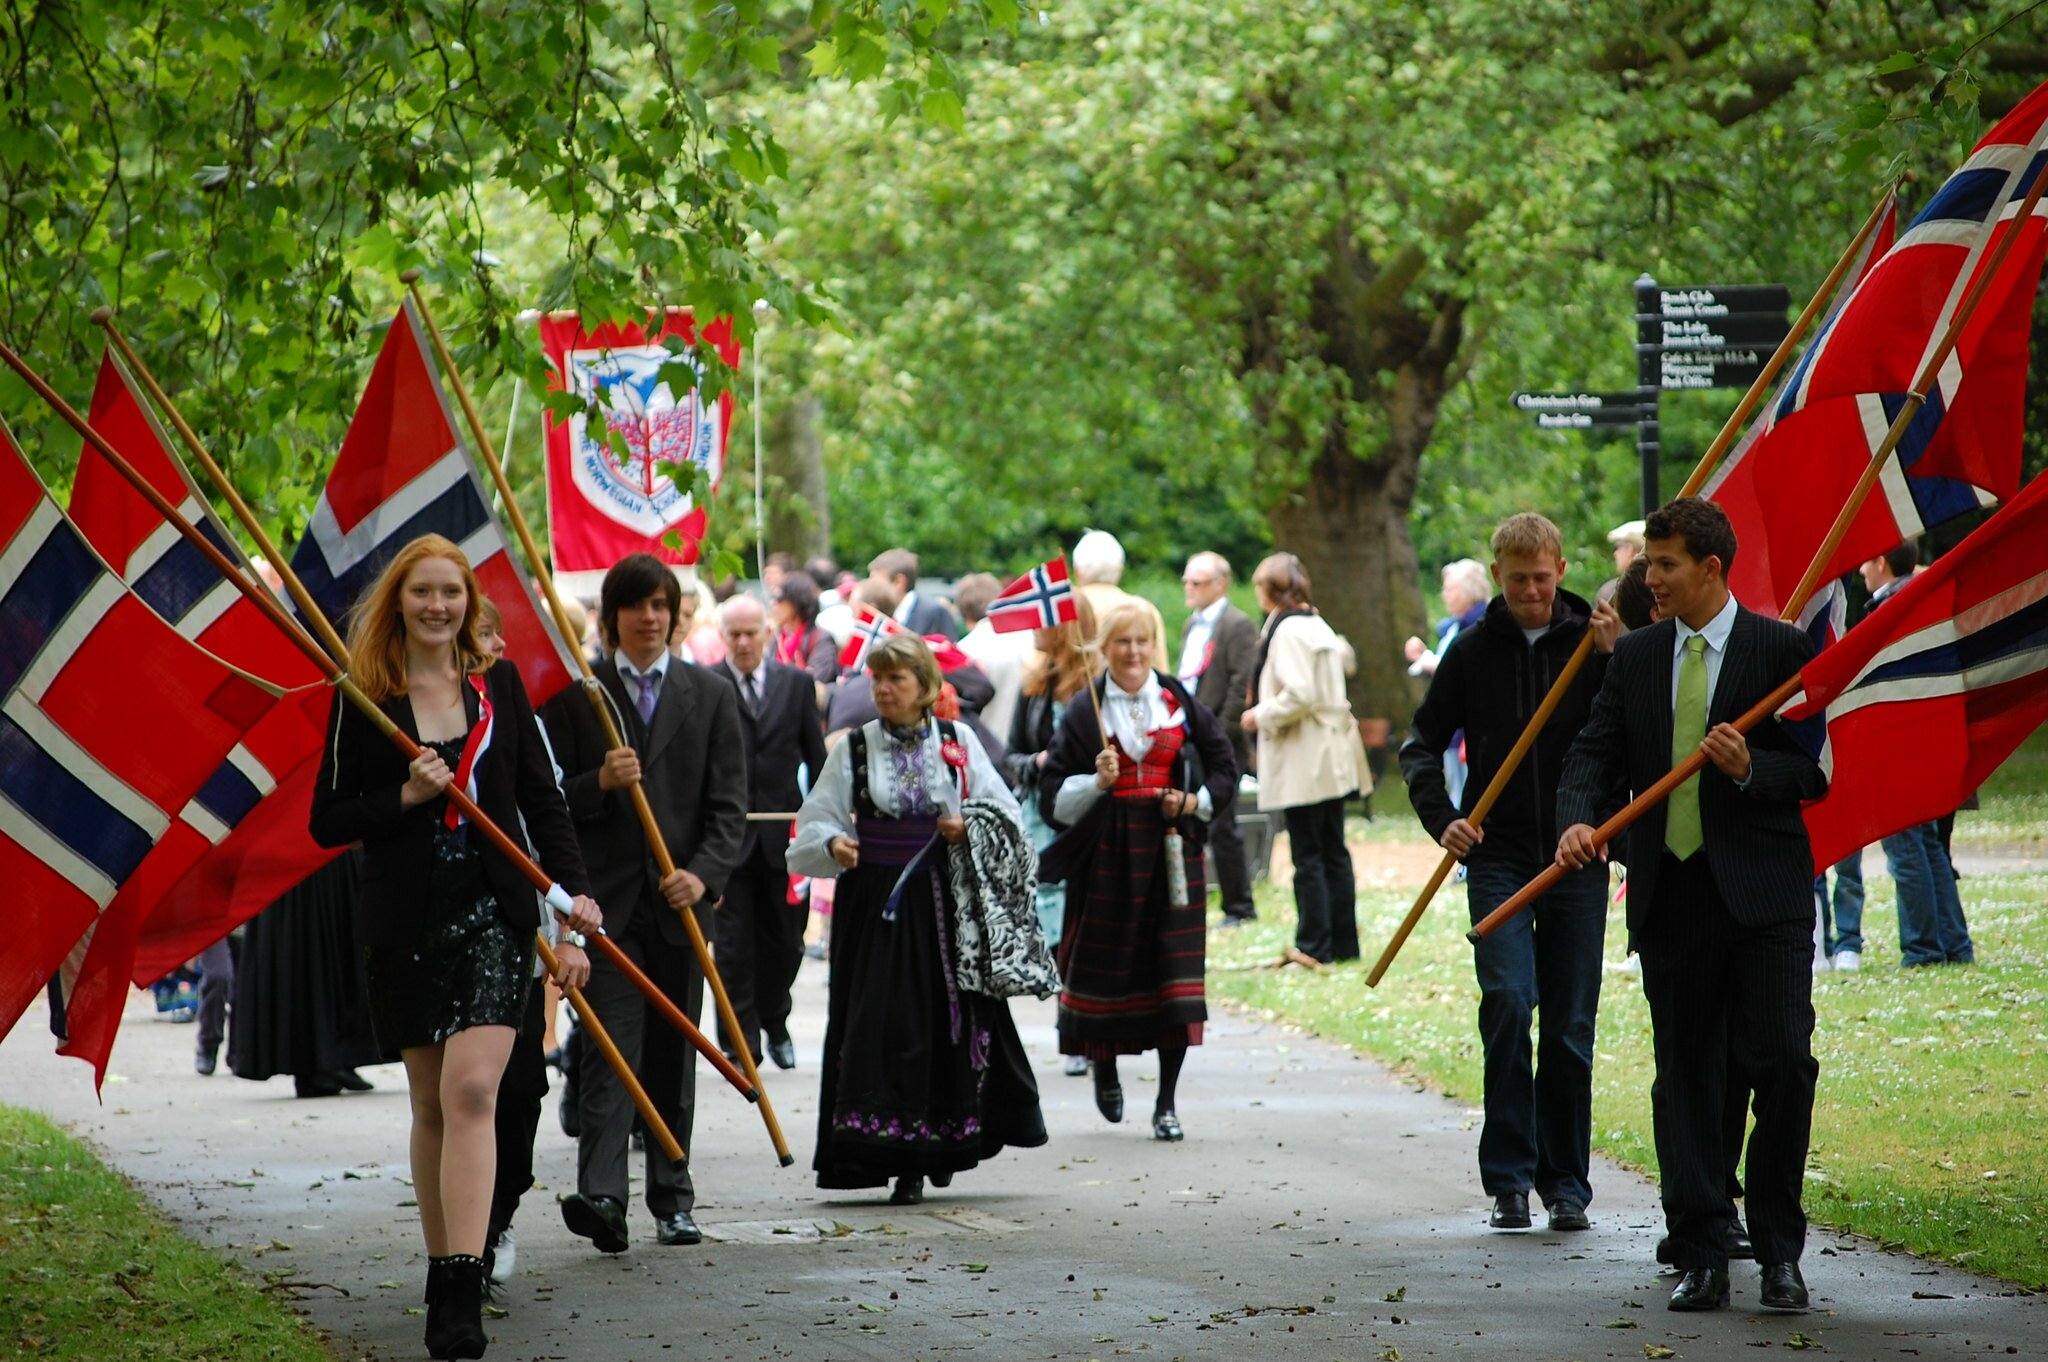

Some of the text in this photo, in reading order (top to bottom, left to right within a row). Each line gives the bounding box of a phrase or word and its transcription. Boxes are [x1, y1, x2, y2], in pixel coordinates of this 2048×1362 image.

[1661, 320, 1709, 334] The Lake
[1701, 332, 1726, 348] Gate
[584, 454, 642, 514] NORWEGIAN
